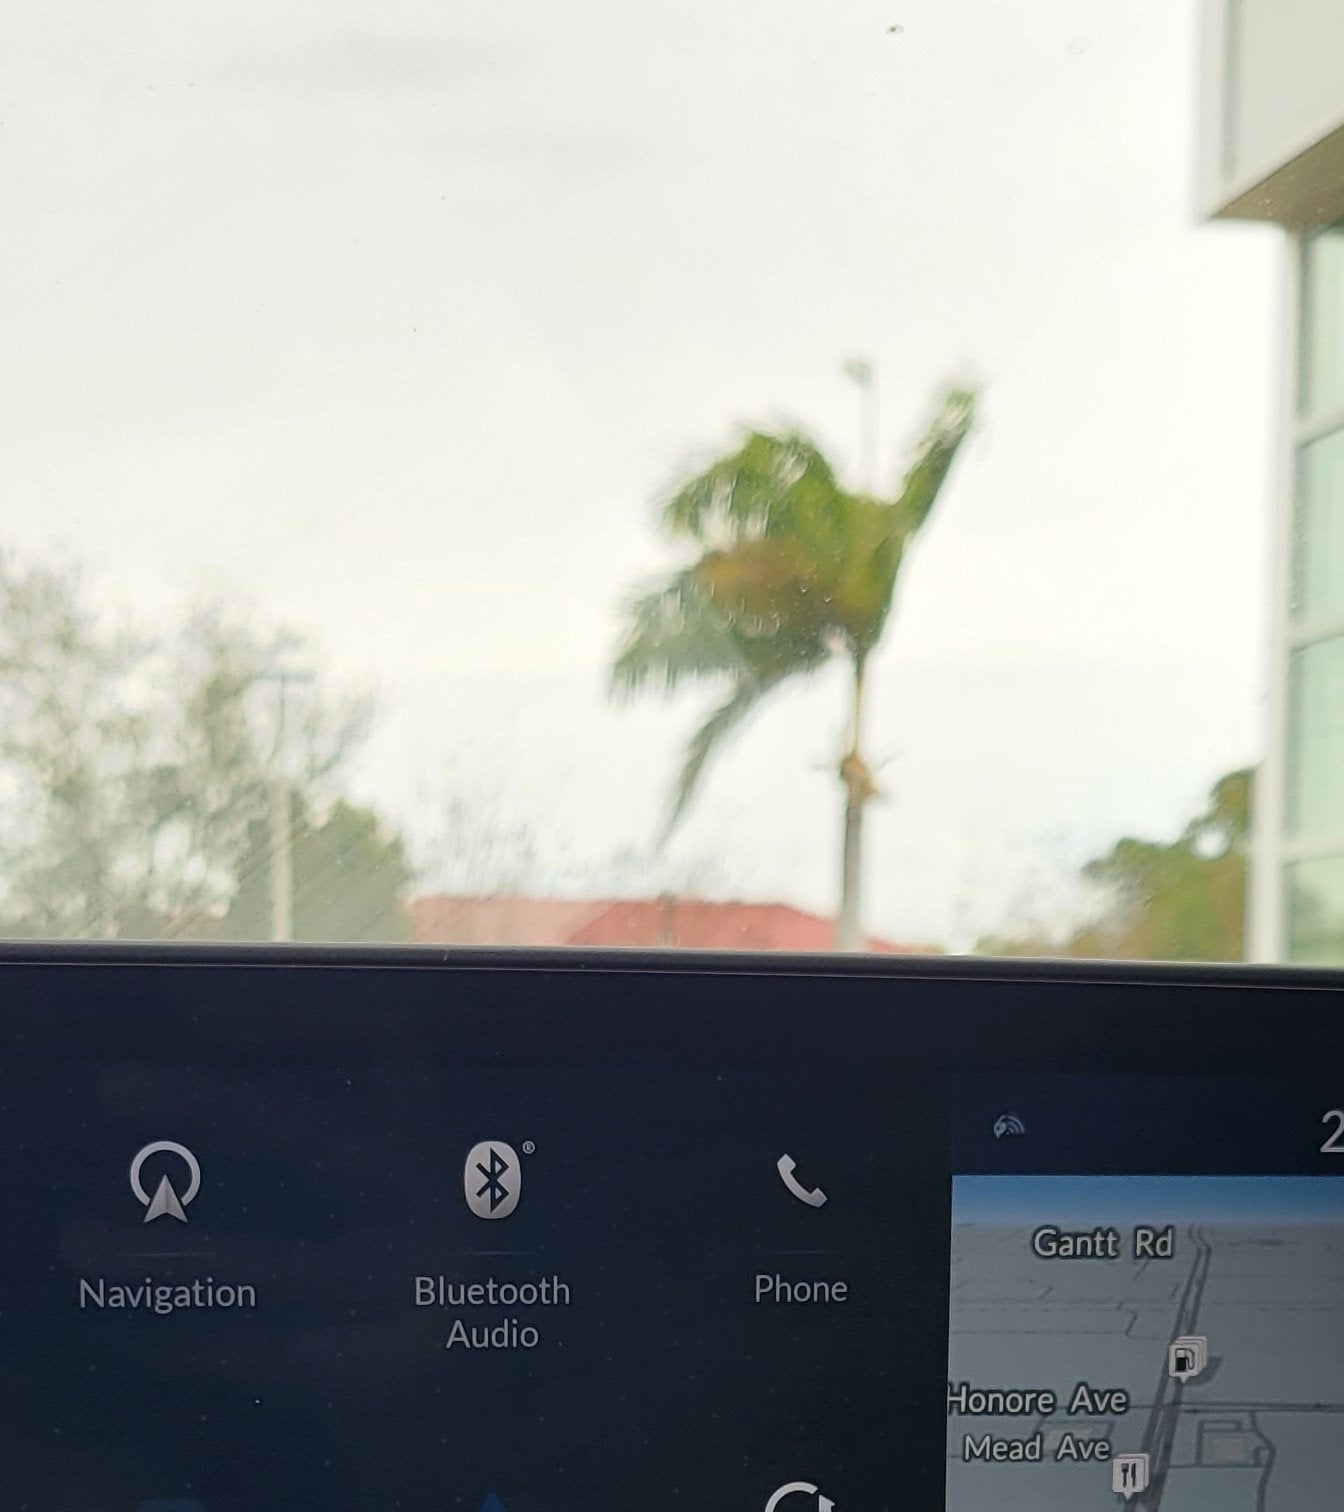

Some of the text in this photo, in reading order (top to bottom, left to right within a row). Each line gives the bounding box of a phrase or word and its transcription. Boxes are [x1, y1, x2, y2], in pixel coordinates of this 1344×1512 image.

[1034, 1228, 1173, 1257] Gantt Rd
[80, 1278, 256, 1314] Navigation
[414, 1276, 571, 1305] Bluetooth
[756, 1274, 848, 1302] Phone
[446, 1319, 539, 1348] Audio
[948, 1385, 1127, 1413] Honore Ave
[964, 1434, 1111, 1461] Mead Ave
